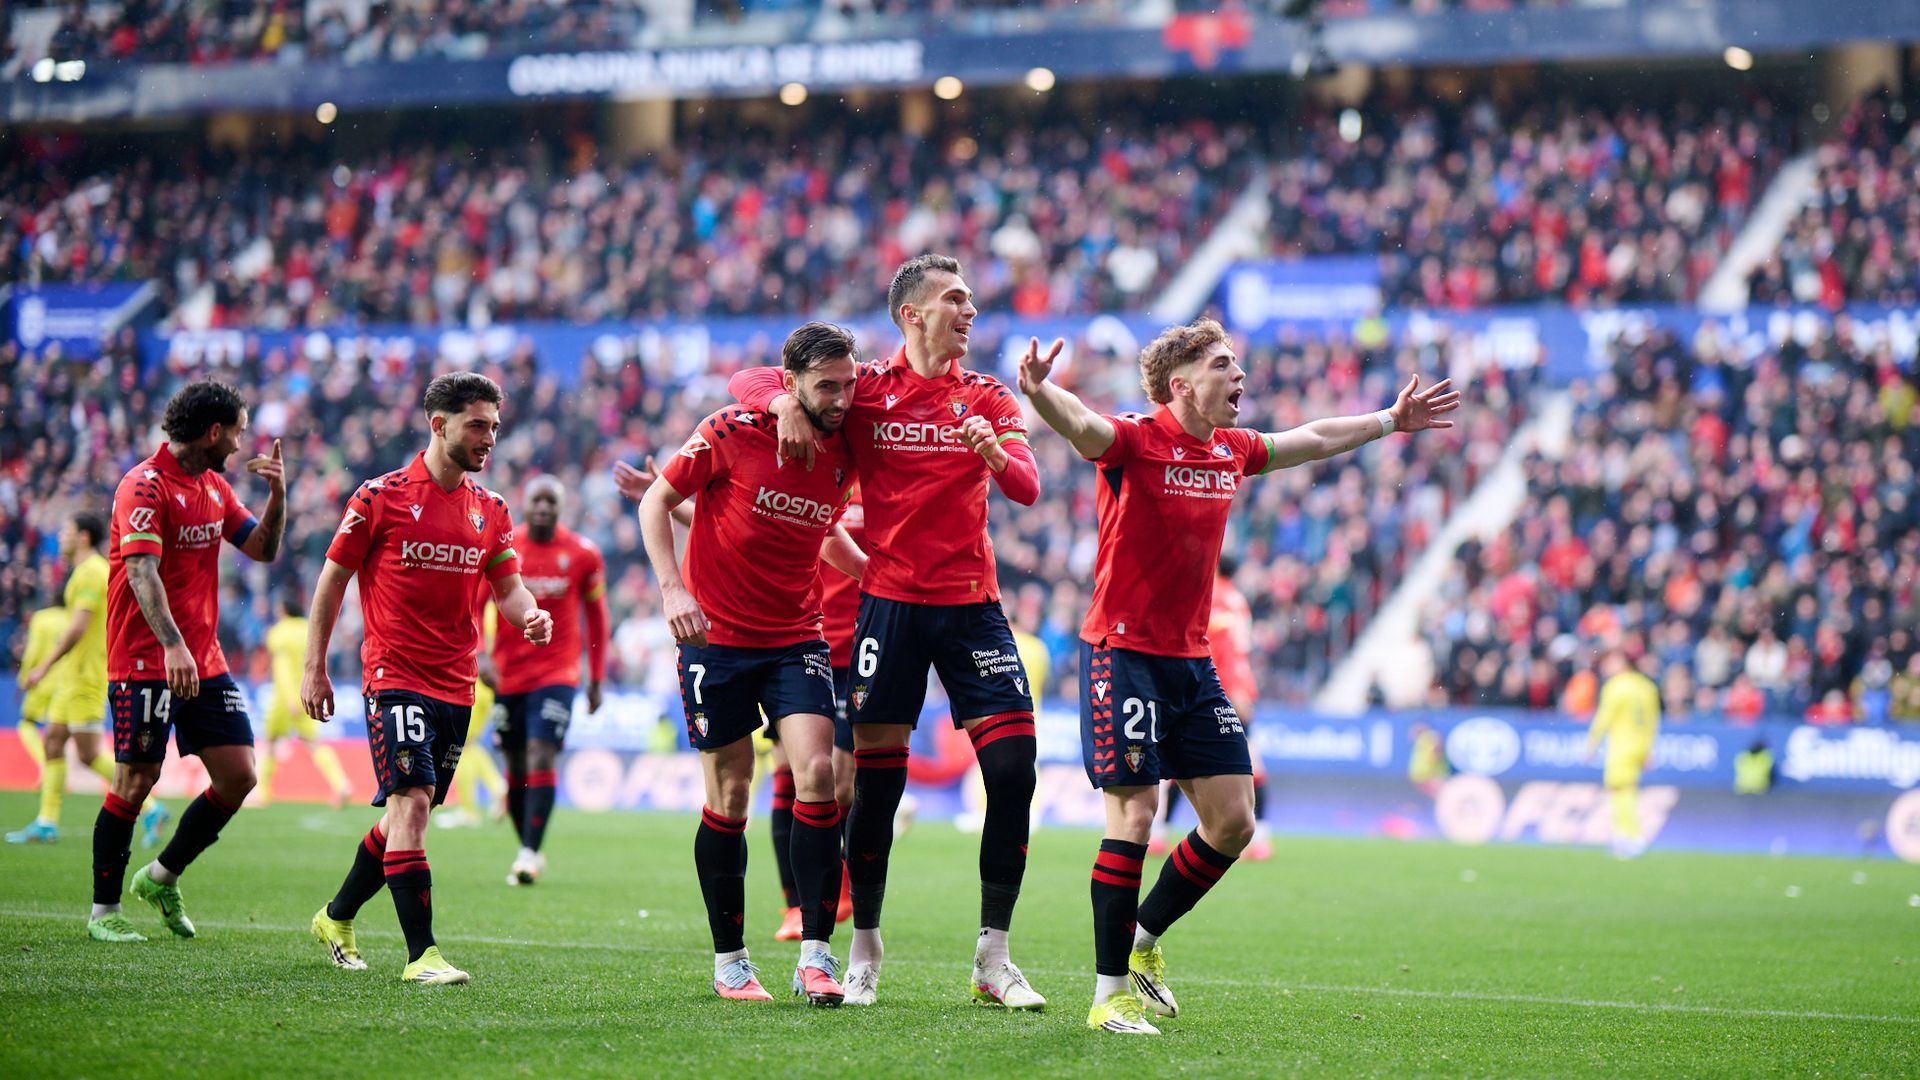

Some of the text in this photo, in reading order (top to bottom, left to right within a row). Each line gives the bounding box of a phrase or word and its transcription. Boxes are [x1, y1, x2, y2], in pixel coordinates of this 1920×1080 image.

[873, 422, 962, 444] Kosne
[805, 667, 816, 675] de
[858, 637, 879, 678] 6
[980, 669, 989, 678] de
[689, 664, 707, 704] 7
[140, 687, 172, 724] 14
[390, 705, 426, 743] 15
[1122, 697, 1158, 743] 21
[1220, 725, 1230, 734] de
